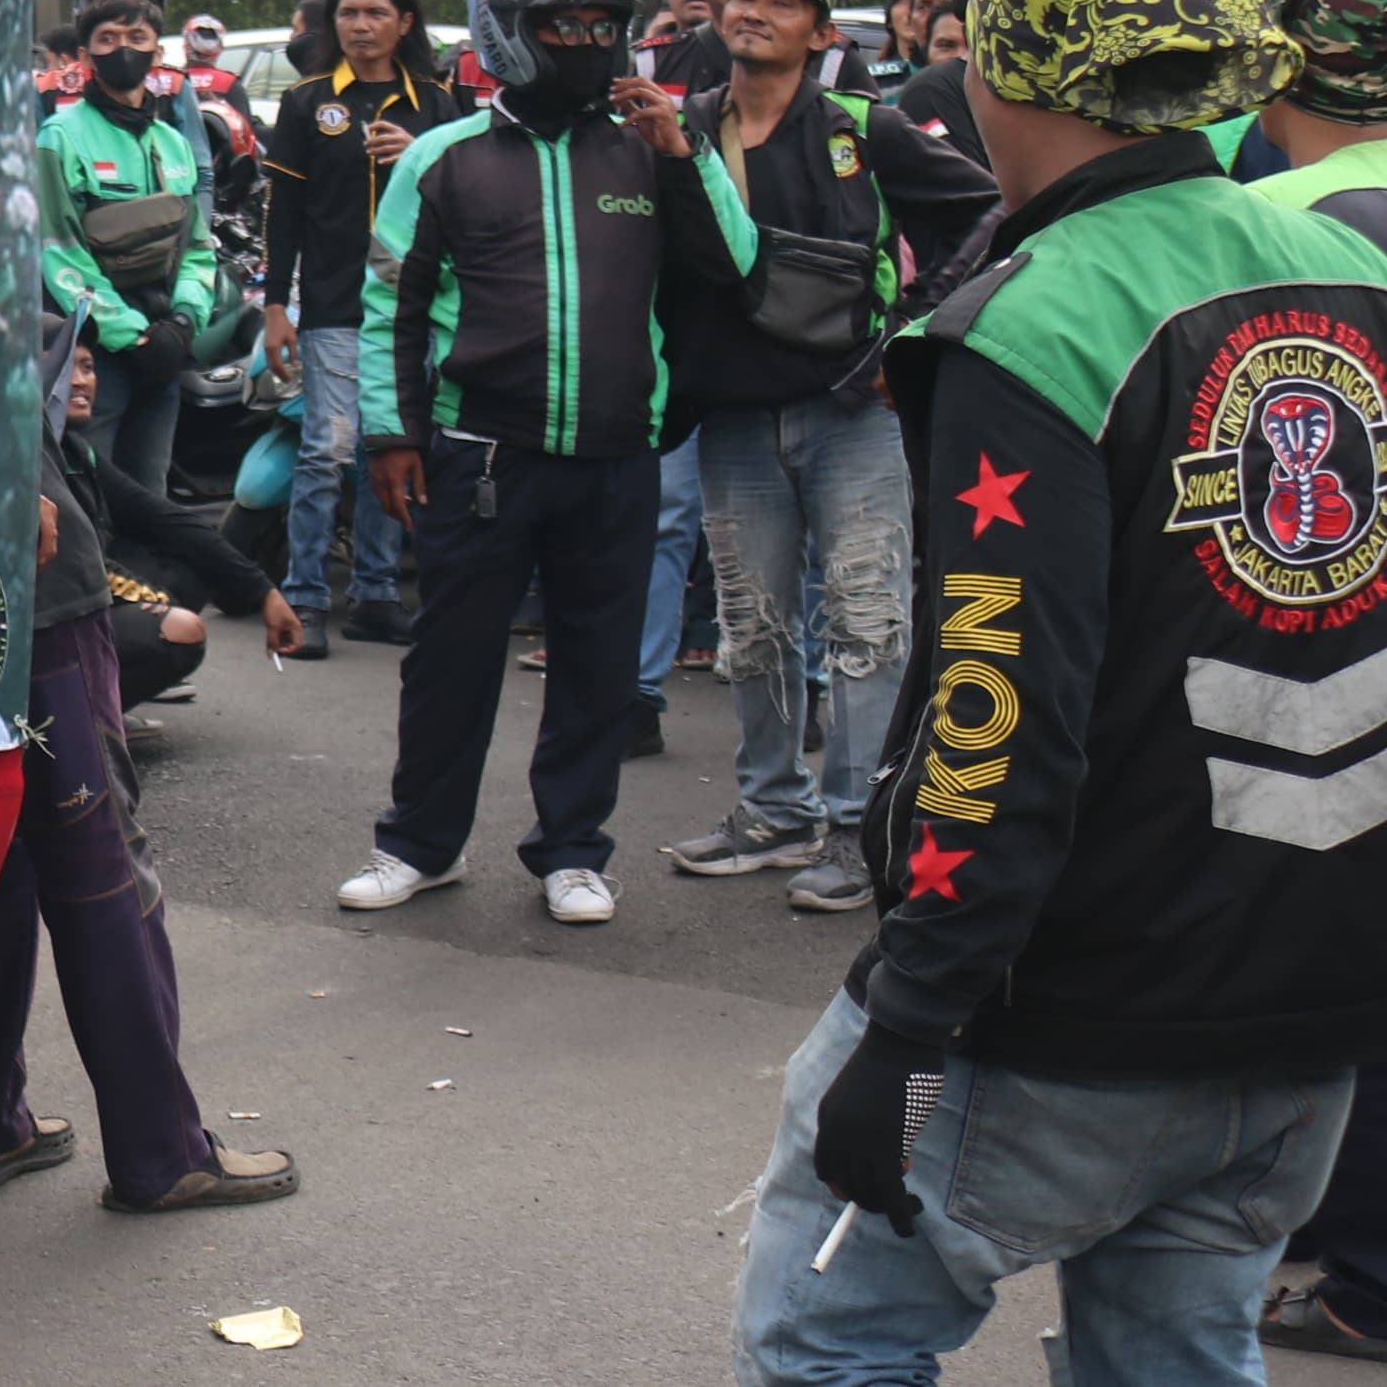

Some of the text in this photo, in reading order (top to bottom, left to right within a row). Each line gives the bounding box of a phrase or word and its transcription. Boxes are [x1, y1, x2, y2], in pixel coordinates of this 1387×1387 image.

[596, 193, 654, 217] Grab
[1253, 310, 1331, 339] HARUS
[1323, 358, 1382, 424] ANGKE
[1183, 467, 1238, 509] SINCE
[1194, 538, 1257, 619] SALAM
[1258, 605, 1316, 634] KOPI
[1232, 541, 1322, 598] JAKARTA
[915, 573, 1023, 824] KON
